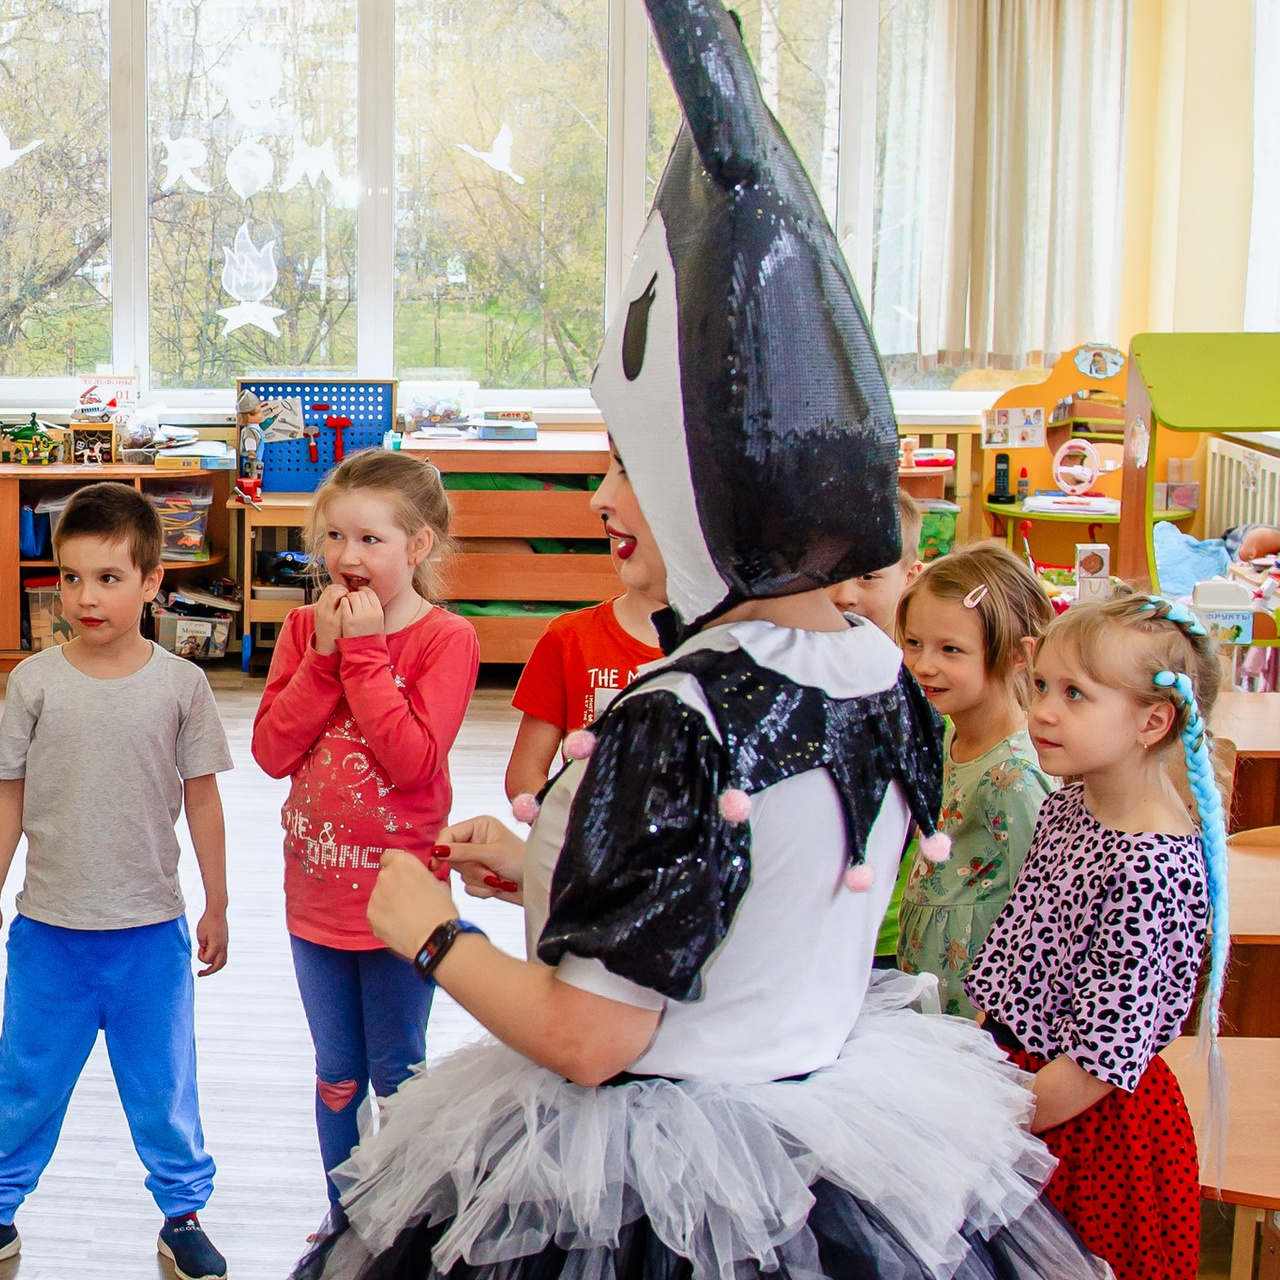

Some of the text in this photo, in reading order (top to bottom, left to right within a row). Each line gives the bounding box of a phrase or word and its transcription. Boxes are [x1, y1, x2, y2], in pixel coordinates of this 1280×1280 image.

[115, 389, 130, 400] 01
[587, 667, 619, 688] THE
[307, 840, 405, 869] DANC
